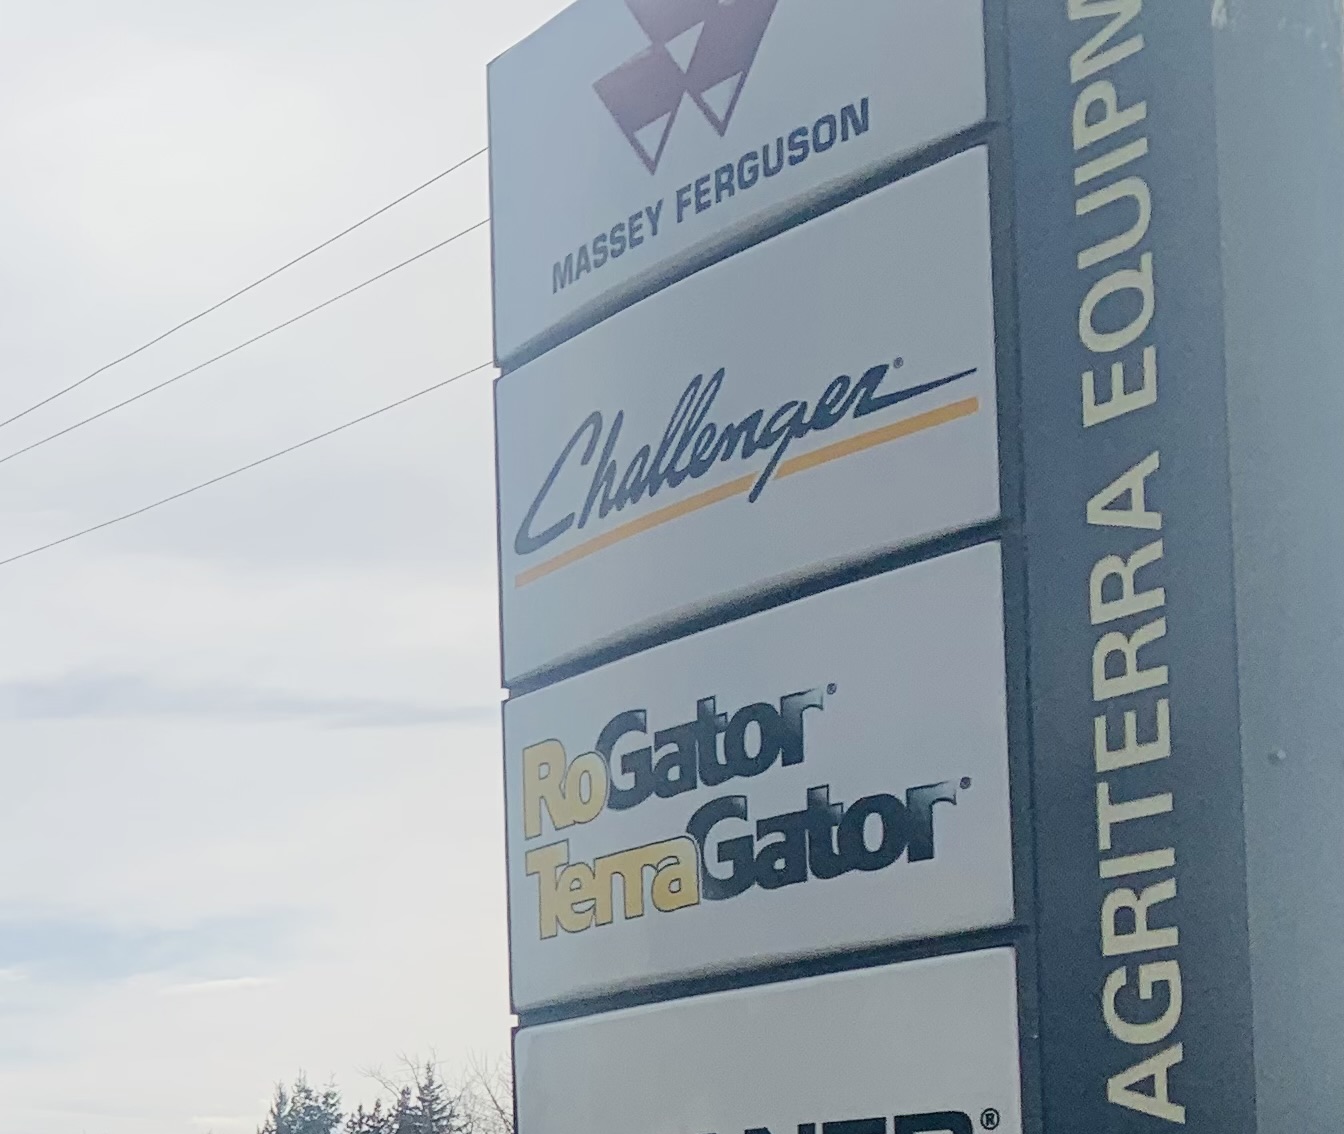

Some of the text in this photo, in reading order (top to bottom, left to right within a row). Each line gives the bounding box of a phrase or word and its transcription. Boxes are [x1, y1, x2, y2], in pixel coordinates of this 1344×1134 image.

[551, 96, 872, 296] MASSEY FERGUSON
[515, 362, 977, 555] Challenger
[522, 692, 824, 839] RoGator
[525, 780, 958, 940] TerraGator
[1085, 451, 1187, 1125] AGRITERRA
